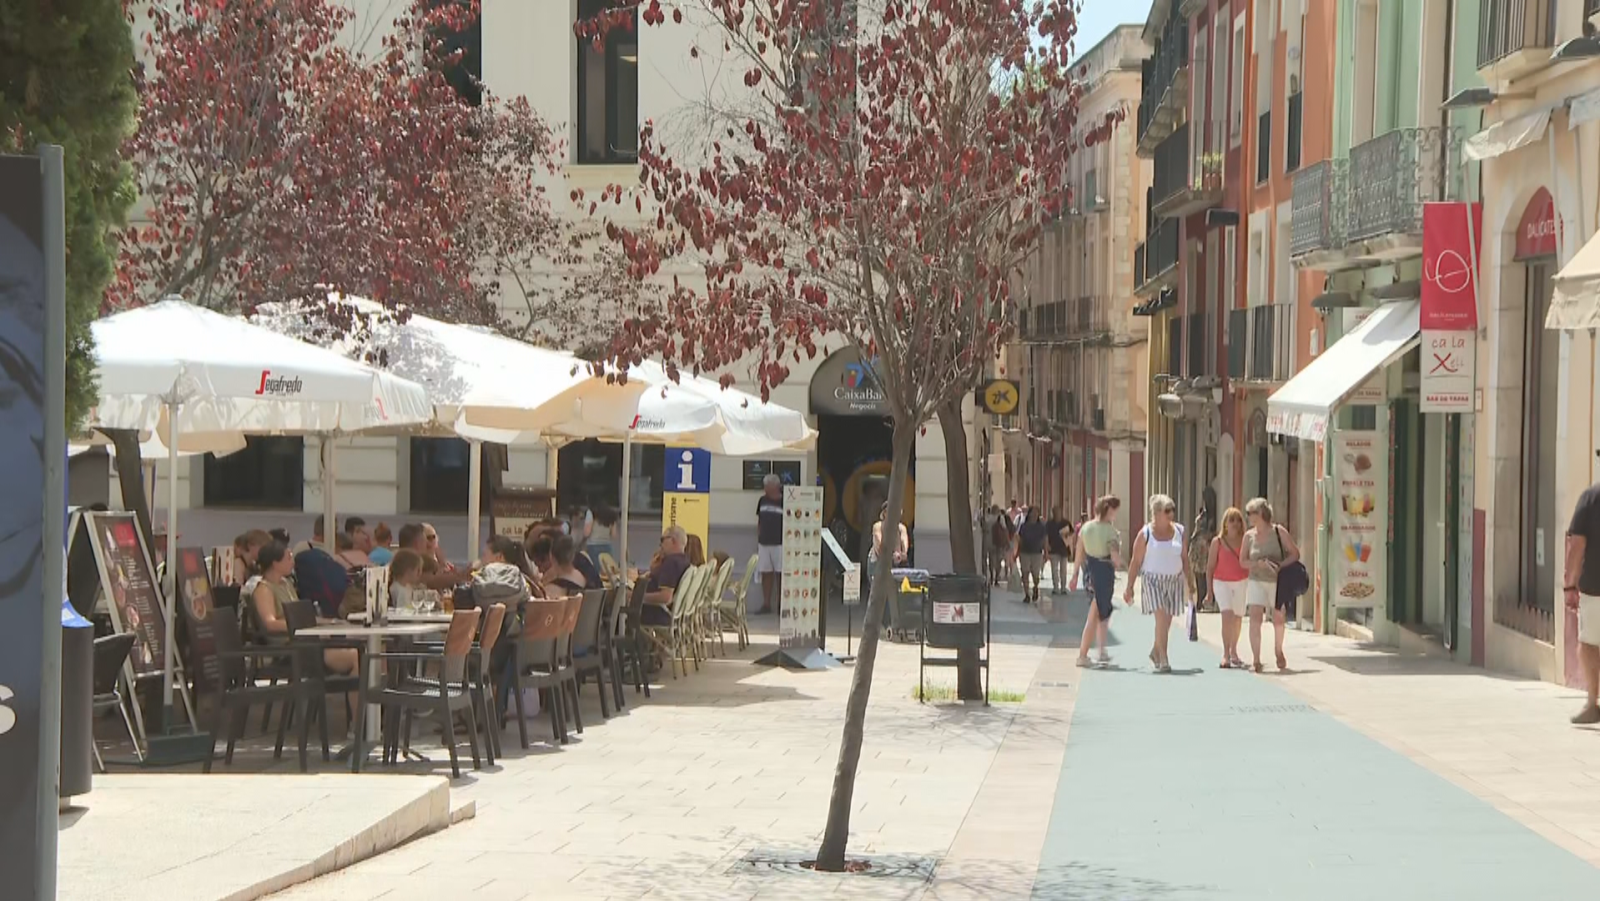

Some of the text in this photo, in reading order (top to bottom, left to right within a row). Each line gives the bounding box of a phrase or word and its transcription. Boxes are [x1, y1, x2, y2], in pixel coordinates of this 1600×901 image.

[1432, 336, 1465, 348] ca la
[255, 370, 302, 395] Segafredo
[834, 387, 882, 400] CaixaBa
